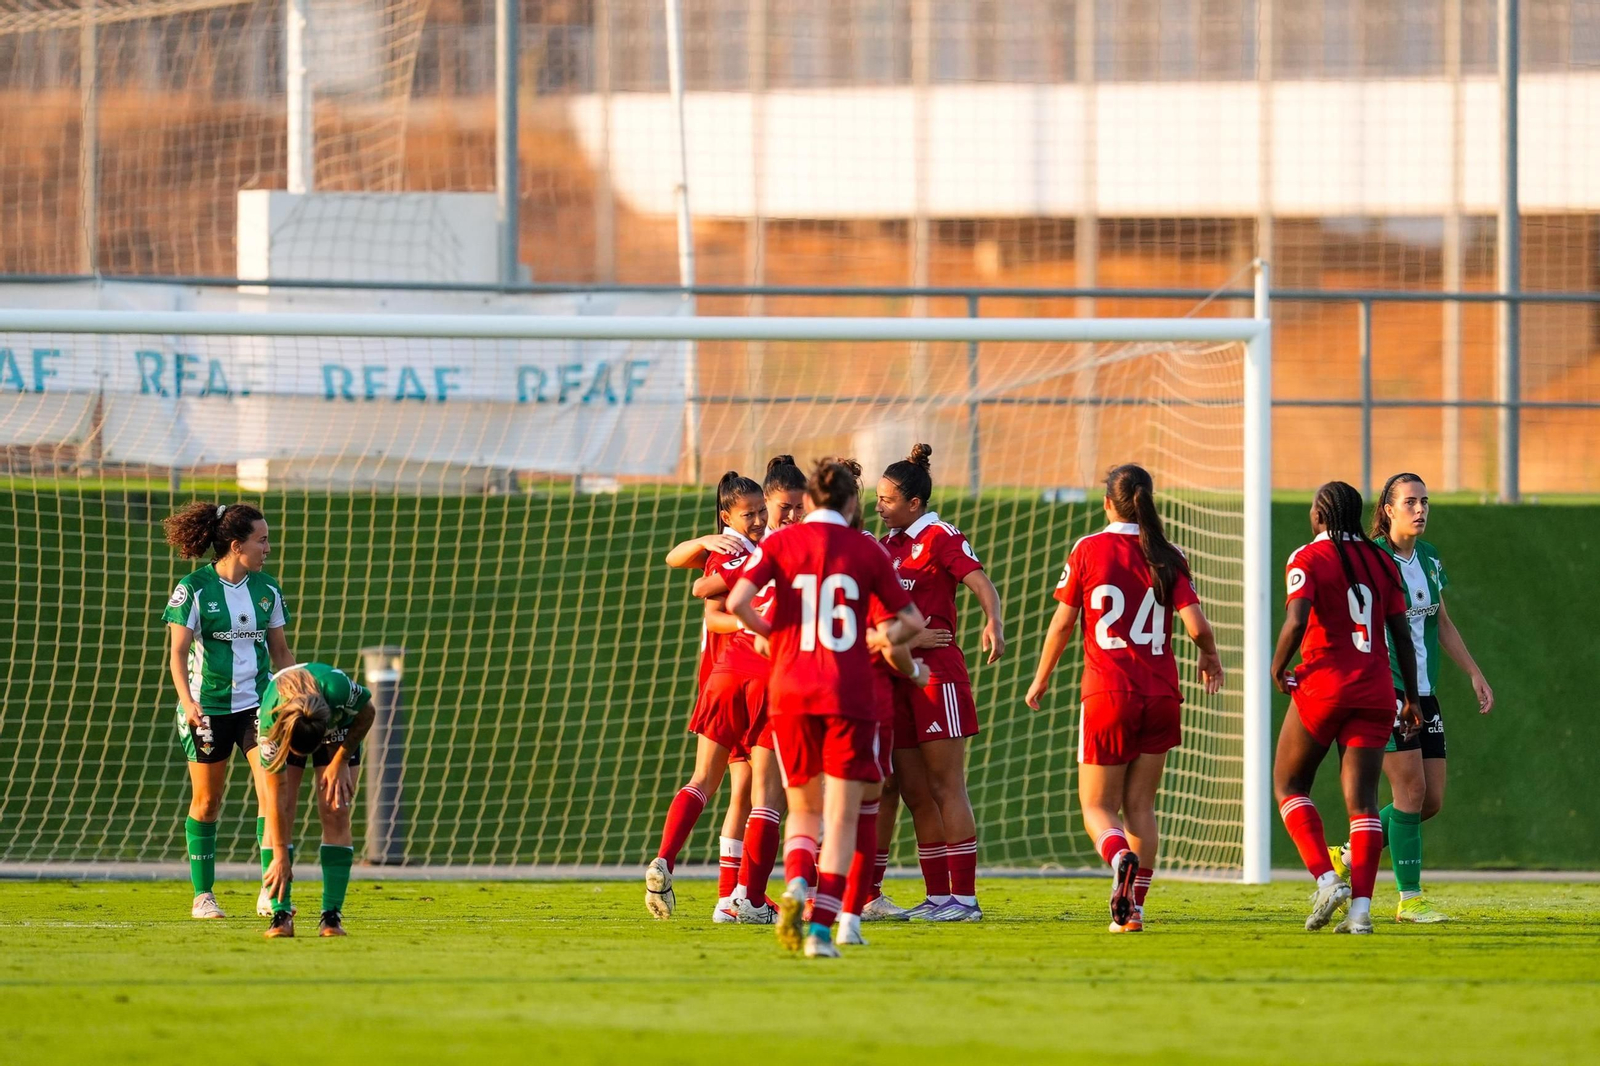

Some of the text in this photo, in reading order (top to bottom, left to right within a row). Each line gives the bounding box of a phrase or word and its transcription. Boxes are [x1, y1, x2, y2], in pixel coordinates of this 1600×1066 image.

[321, 363, 461, 404] RFAF
[516, 359, 650, 404] RFAF
[791, 573, 860, 653] 16
[1090, 584, 1167, 656] 24
[1347, 583, 1374, 654] 9
